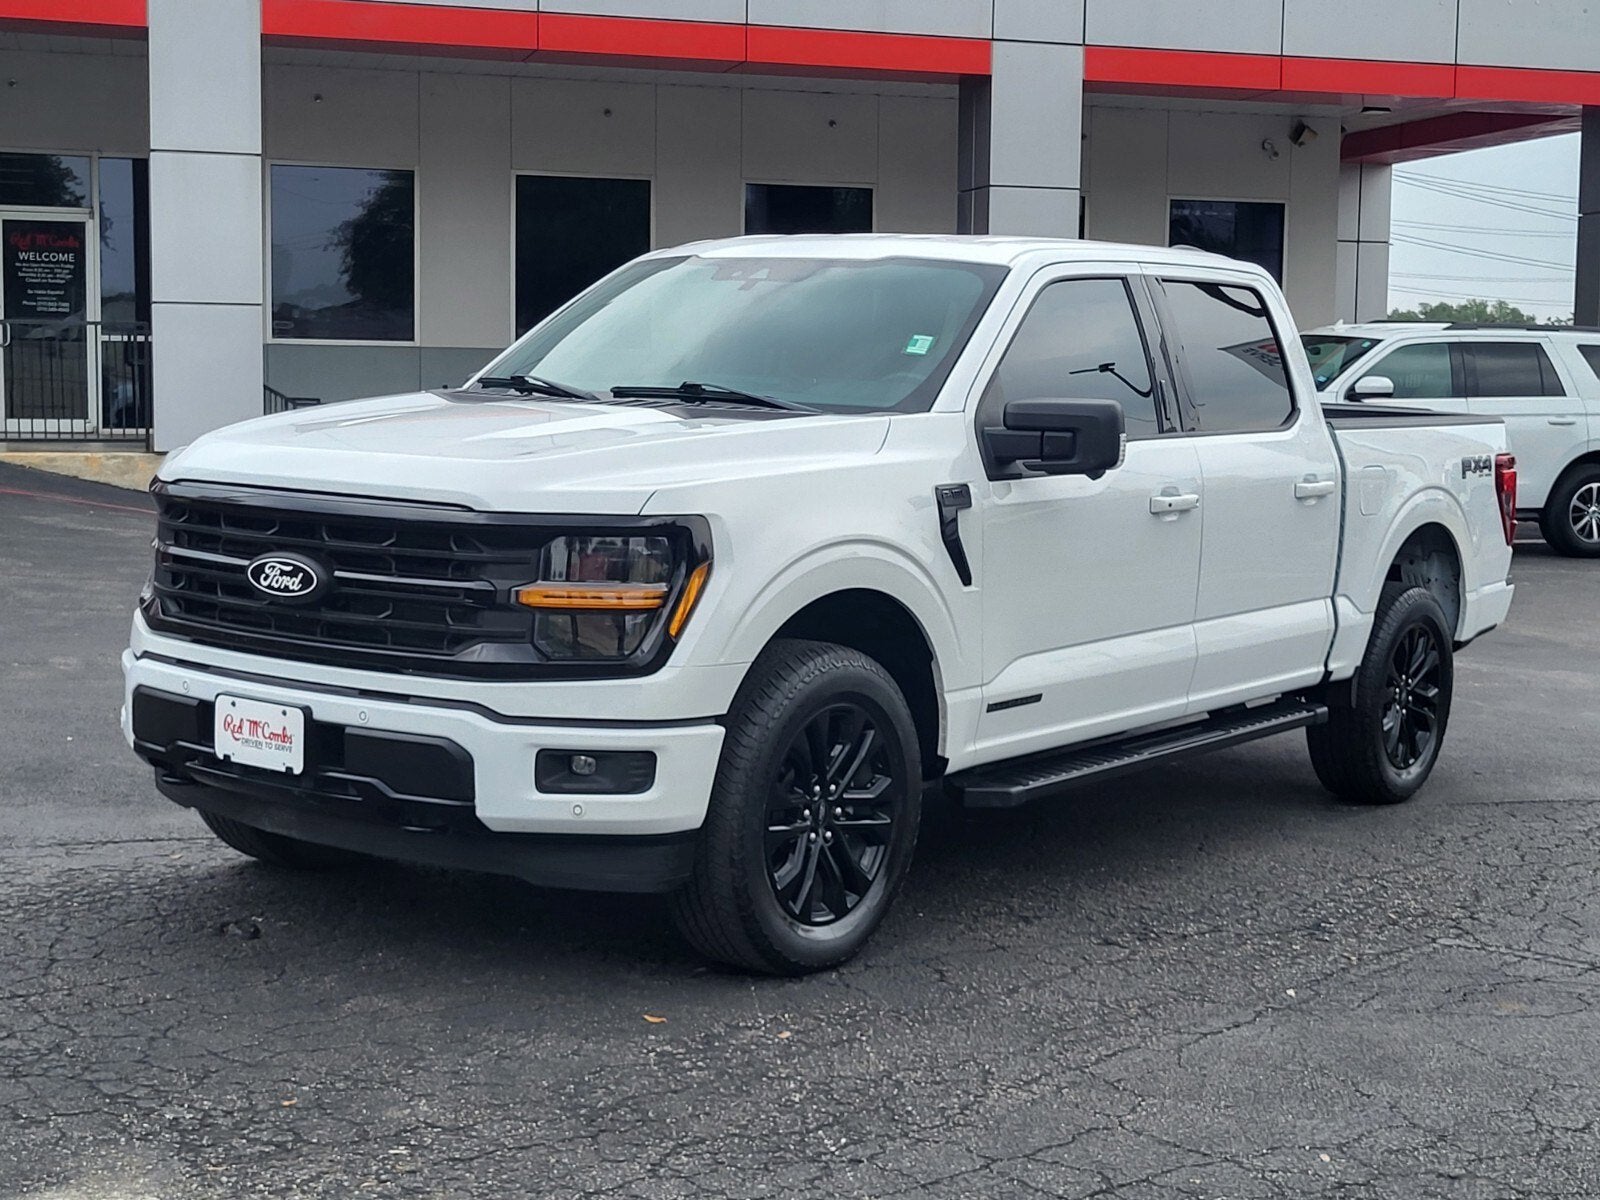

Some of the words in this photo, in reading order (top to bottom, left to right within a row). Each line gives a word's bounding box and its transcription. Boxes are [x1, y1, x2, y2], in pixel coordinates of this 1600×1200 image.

[18, 251, 75, 262] WELCOME
[260, 562, 304, 591] Ford
[223, 713, 244, 741] Red
[245, 718, 293, 745] McCombs
[241, 737, 263, 750] DRIVEN
[264, 741, 274, 751] TO
[274, 743, 293, 754] SERVE
